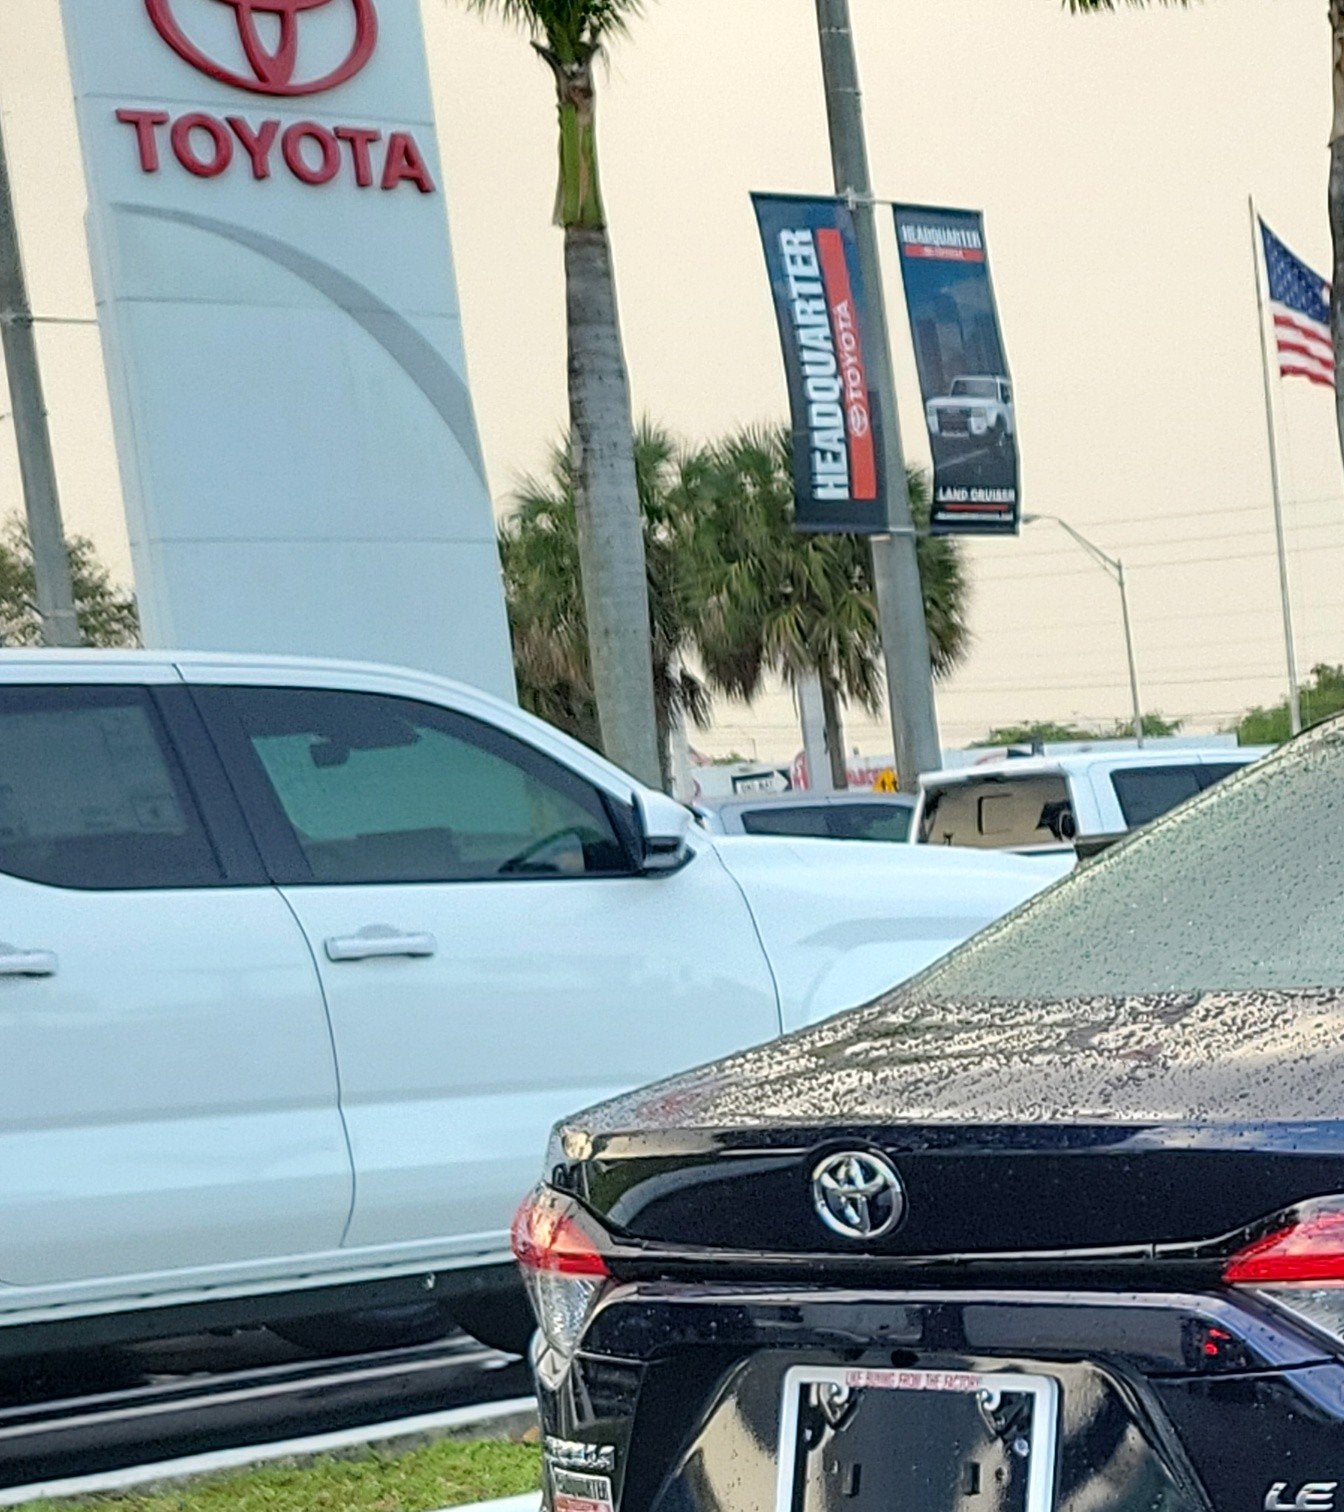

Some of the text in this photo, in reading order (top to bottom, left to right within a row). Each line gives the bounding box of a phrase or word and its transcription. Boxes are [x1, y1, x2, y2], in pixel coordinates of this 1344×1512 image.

[115, 107, 437, 193] TOYOTA
[780, 227, 850, 500] HEADQUARTER
[832, 299, 867, 408] TOYOTA
[937, 486, 969, 502] LAND
[1264, 1481, 1338, 1511] LE
